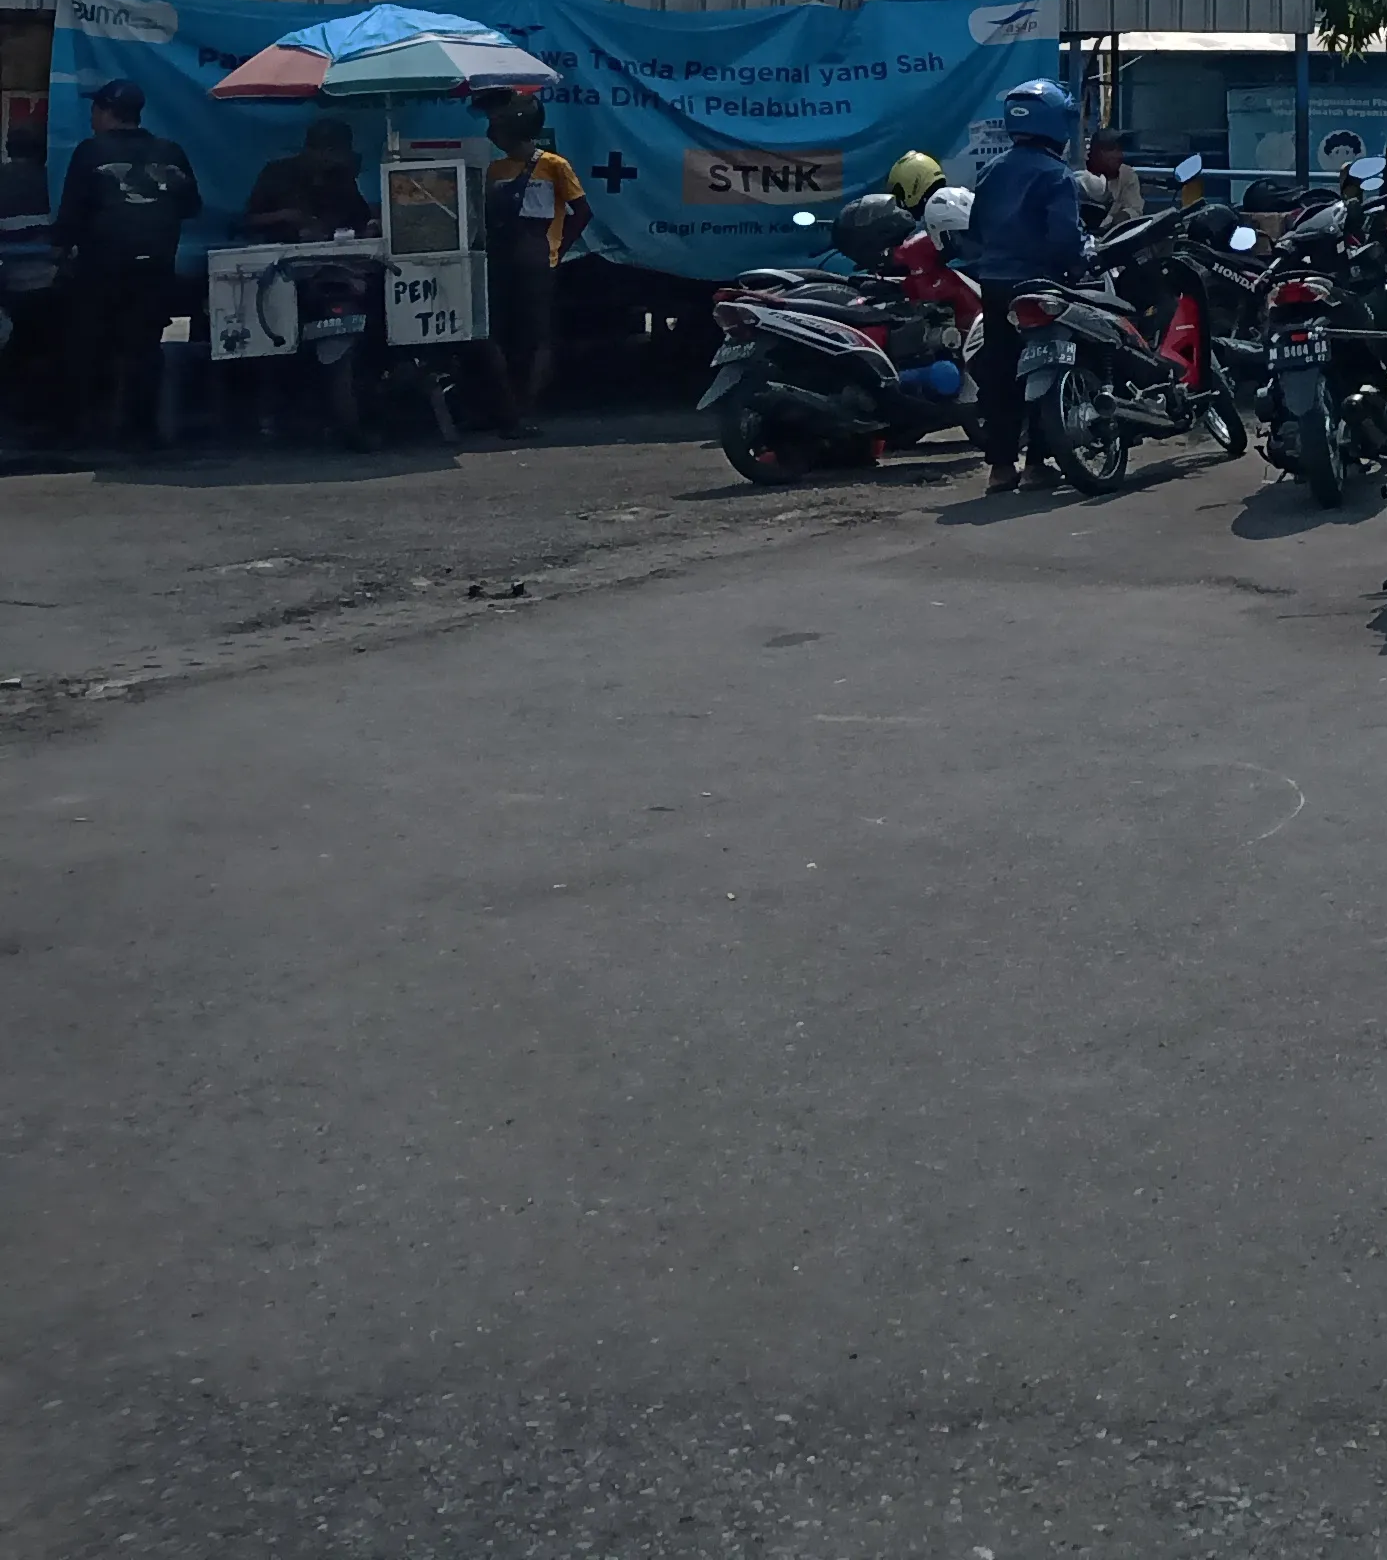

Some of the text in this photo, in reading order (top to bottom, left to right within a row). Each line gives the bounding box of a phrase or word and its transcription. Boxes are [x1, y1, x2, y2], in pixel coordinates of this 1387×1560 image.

[590, 49, 675, 81] Tanda
[684, 56, 810, 85] Pengenal
[819, 60, 888, 87] yang
[896, 52, 945, 74] Sah
[705, 95, 853, 118] Pelabuhan
[708, 163, 823, 192] STNK
[394, 277, 438, 305] PEN
[1211, 262, 1257, 293] HONDA
[414, 309, 460, 337] TOL
